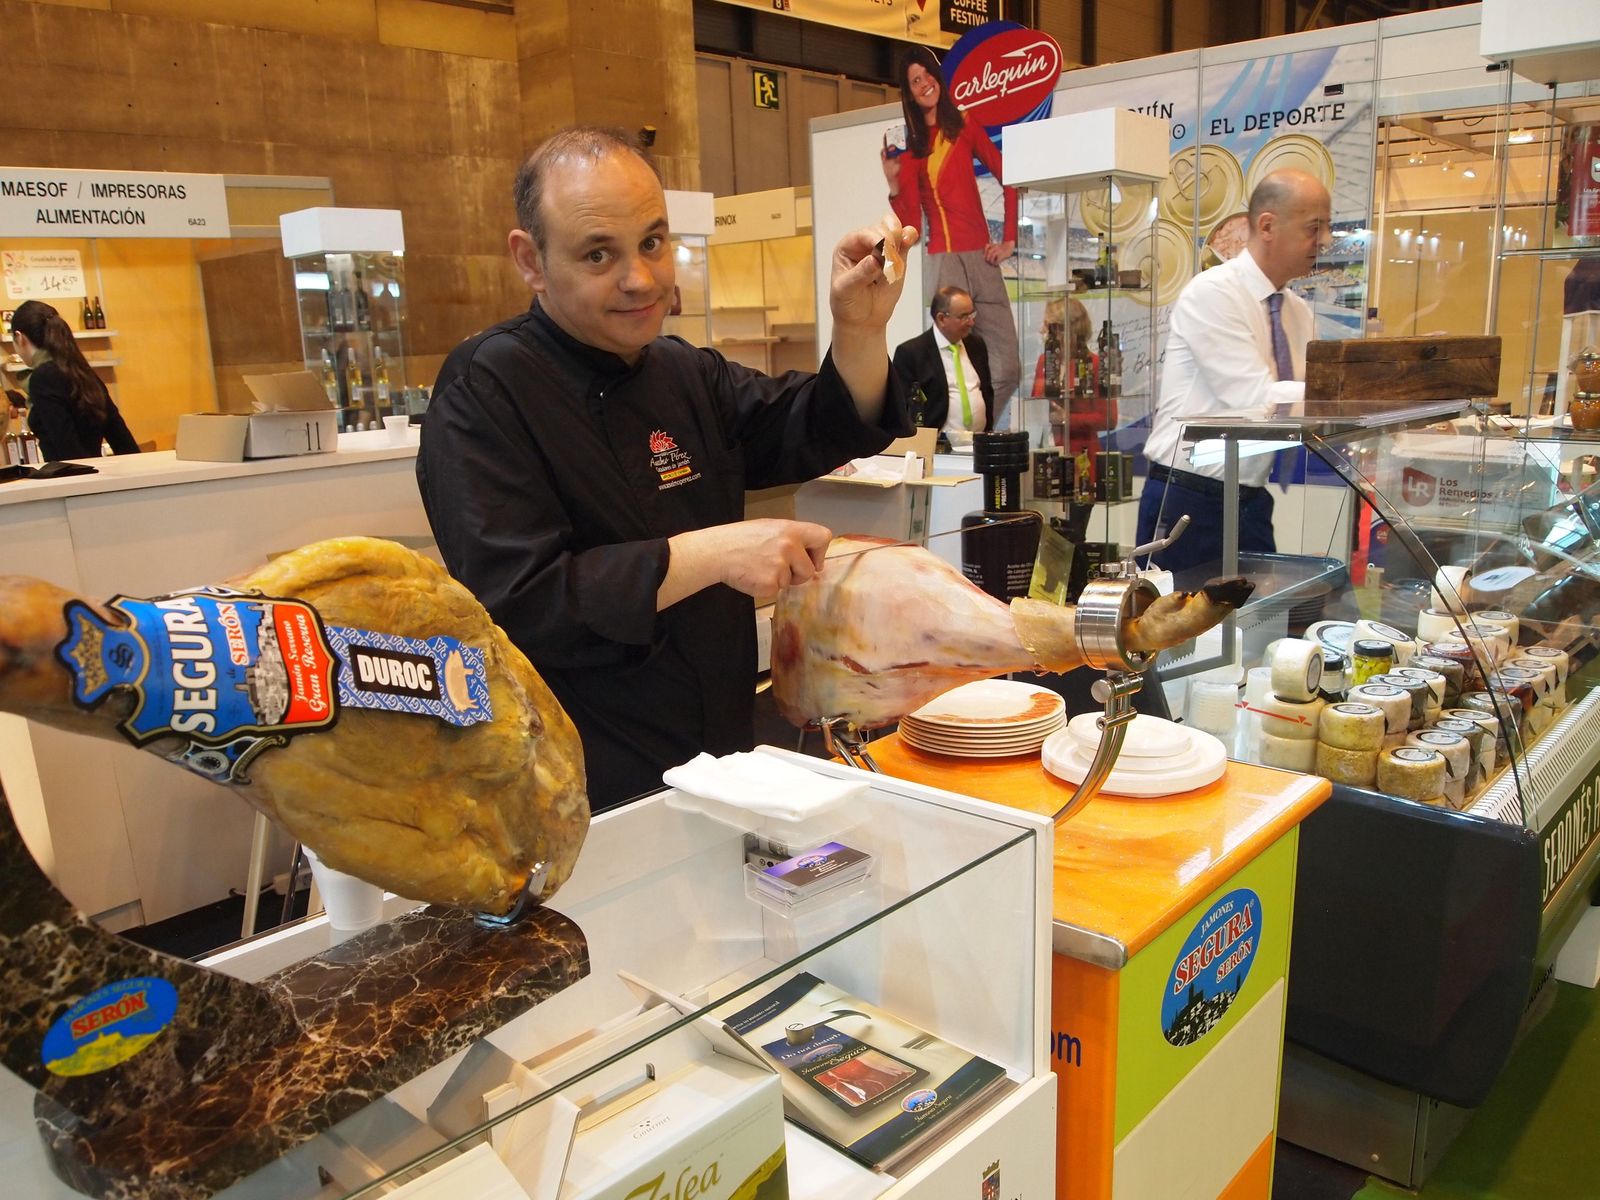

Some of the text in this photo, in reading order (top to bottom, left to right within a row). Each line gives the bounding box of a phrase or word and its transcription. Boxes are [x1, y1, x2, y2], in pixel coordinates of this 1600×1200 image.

[1210, 118, 1235, 136] EL
[1243, 102, 1346, 132] DEPORTE
[1, 181, 68, 197] MAESOF
[91, 183, 187, 200] IMPRESORAS
[36, 206, 146, 225] ALIMENTACIÓN
[1440, 478, 1458, 486] Los
[216, 602, 249, 665] SERÓN
[154, 596, 217, 734] SEGURA
[284, 620, 307, 703] Jamón Serrano
[299, 613, 328, 713] Gran Reserva
[357, 654, 433, 692] DUROC
[1543, 784, 1592, 902] SERONÉS
[1200, 900, 1234, 938] JAMONES
[1173, 903, 1254, 996] SEGURA
[1216, 937, 1254, 984] SERÓN
[71, 991, 147, 1039] SERÓN
